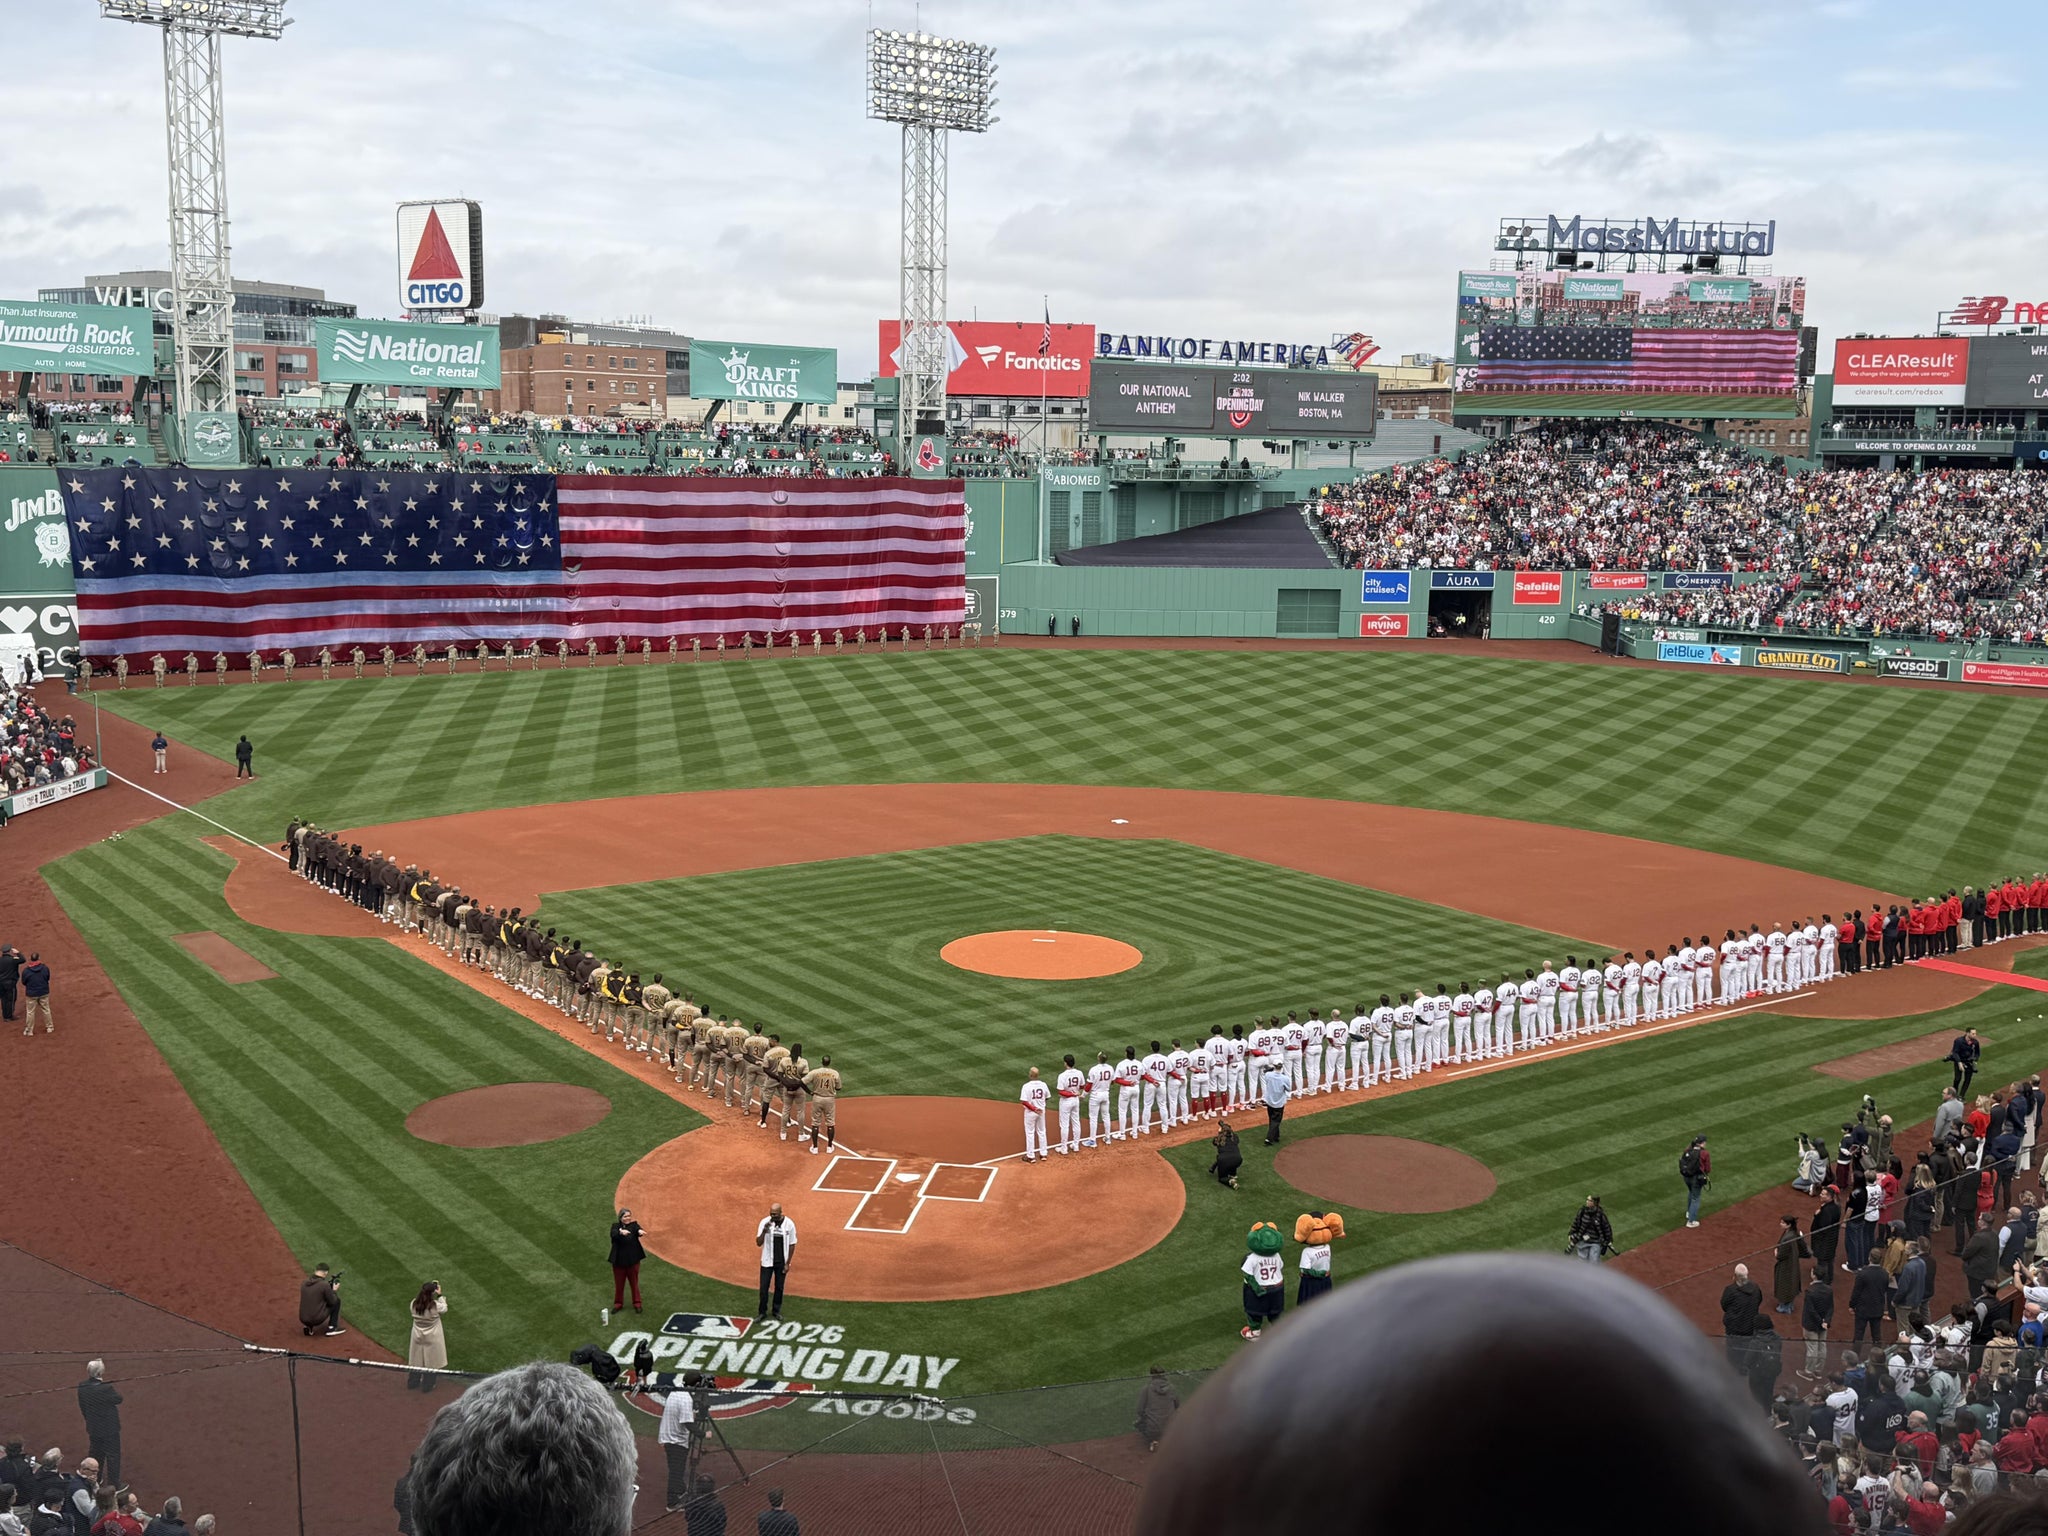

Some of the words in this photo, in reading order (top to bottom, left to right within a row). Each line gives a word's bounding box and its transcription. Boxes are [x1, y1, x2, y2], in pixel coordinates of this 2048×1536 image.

[1548, 214, 1776, 255] MassMutual
[408, 282, 463, 304] CITGO
[21, 308, 37, 317] Just
[39, 308, 78, 319] Insurance.
[84, 324, 134, 344] Rock
[368, 334, 484, 364] National
[1100, 333, 1173, 358] BANK
[1180, 338, 1212, 358] OF
[1219, 340, 1329, 366] AMERICA
[1004, 352, 1081, 372] Fanatics
[1848, 353, 1954, 368] CLEAResult
[410, 365, 432, 376] Car
[437, 366, 478, 378] Rental
[726, 364, 800, 383] DRAFT
[1233, 373, 1250, 382] 2:02
[2028, 374, 2044, 384] AT
[736, 380, 798, 398] KINGS
[1120, 384, 1139, 396] OUR
[1142, 386, 1191, 398] NATIONAL
[1241, 389, 1254, 397] 2026
[1298, 392, 1311, 401] NIK
[1313, 392, 1345, 403] WALKER
[1136, 402, 1176, 414] ANTHEM
[1216, 397, 1249, 411] OPENING
[1249, 399, 1264, 411] DAY
[1298, 408, 1330, 419] BOSTON,
[1331, 409, 1342, 418] MA
[1053, 474, 1100, 487] ABIOMED
[4, 497, 45, 532] JIM
[1366, 579, 1381, 588] city
[1516, 582, 1560, 590] Safelite
[1612, 576, 1646, 586] TICKET
[1365, 586, 1395, 594] cruises
[1000, 610, 1016, 618] 379
[1368, 621, 1401, 630] IRVING
[1662, 646, 1704, 659] jetBlue
[1758, 652, 1810, 664] GRANITE
[1812, 653, 1839, 670] CITY
[1887, 660, 1938, 672] wasabi
[73, 778, 87, 789] TRULY
[40, 788, 54, 799] TRULY
[1673, 962, 1678, 970] 2
[1653, 967, 1658, 976] 7
[1506, 988, 1516, 997] 44
[1462, 1001, 1472, 1010] 50
[1482, 996, 1491, 1006] 47
[682, 1014, 692, 1024] 30
[1382, 1014, 1393, 1023] 63
[1403, 1012, 1413, 1021] 57
[1314, 1026, 1322, 1036] 71
[1334, 1029, 1346, 1038] 67
[715, 1035, 720, 1045] 5
[731, 1037, 740, 1046] 13
[1258, 1036, 1270, 1047] 89
[1273, 1036, 1284, 1045] 79
[754, 1047, 758, 1056] 3
[1215, 1045, 1223, 1054] 11
[1237, 1045, 1243, 1054] 3
[1150, 1061, 1165, 1071] 40
[1176, 1058, 1189, 1068] 52
[1198, 1057, 1205, 1066] 5
[787, 1066, 798, 1076] 23
[1100, 1071, 1111, 1081] 10
[1126, 1066, 1138, 1076] 16
[820, 1079, 829, 1088] 14
[1068, 1077, 1078, 1088] 19
[1032, 1089, 1043, 1099] 13
[1260, 1267, 1277, 1280] 97
[752, 1320, 846, 1344] 2026
[604, 1330, 844, 1380] OPENING
[842, 1350, 960, 1389] DAY
[1840, 1399, 1857, 1417] 34
[1986, 1412, 1998, 1429] 35
[1869, 1496, 1884, 1511] 19
